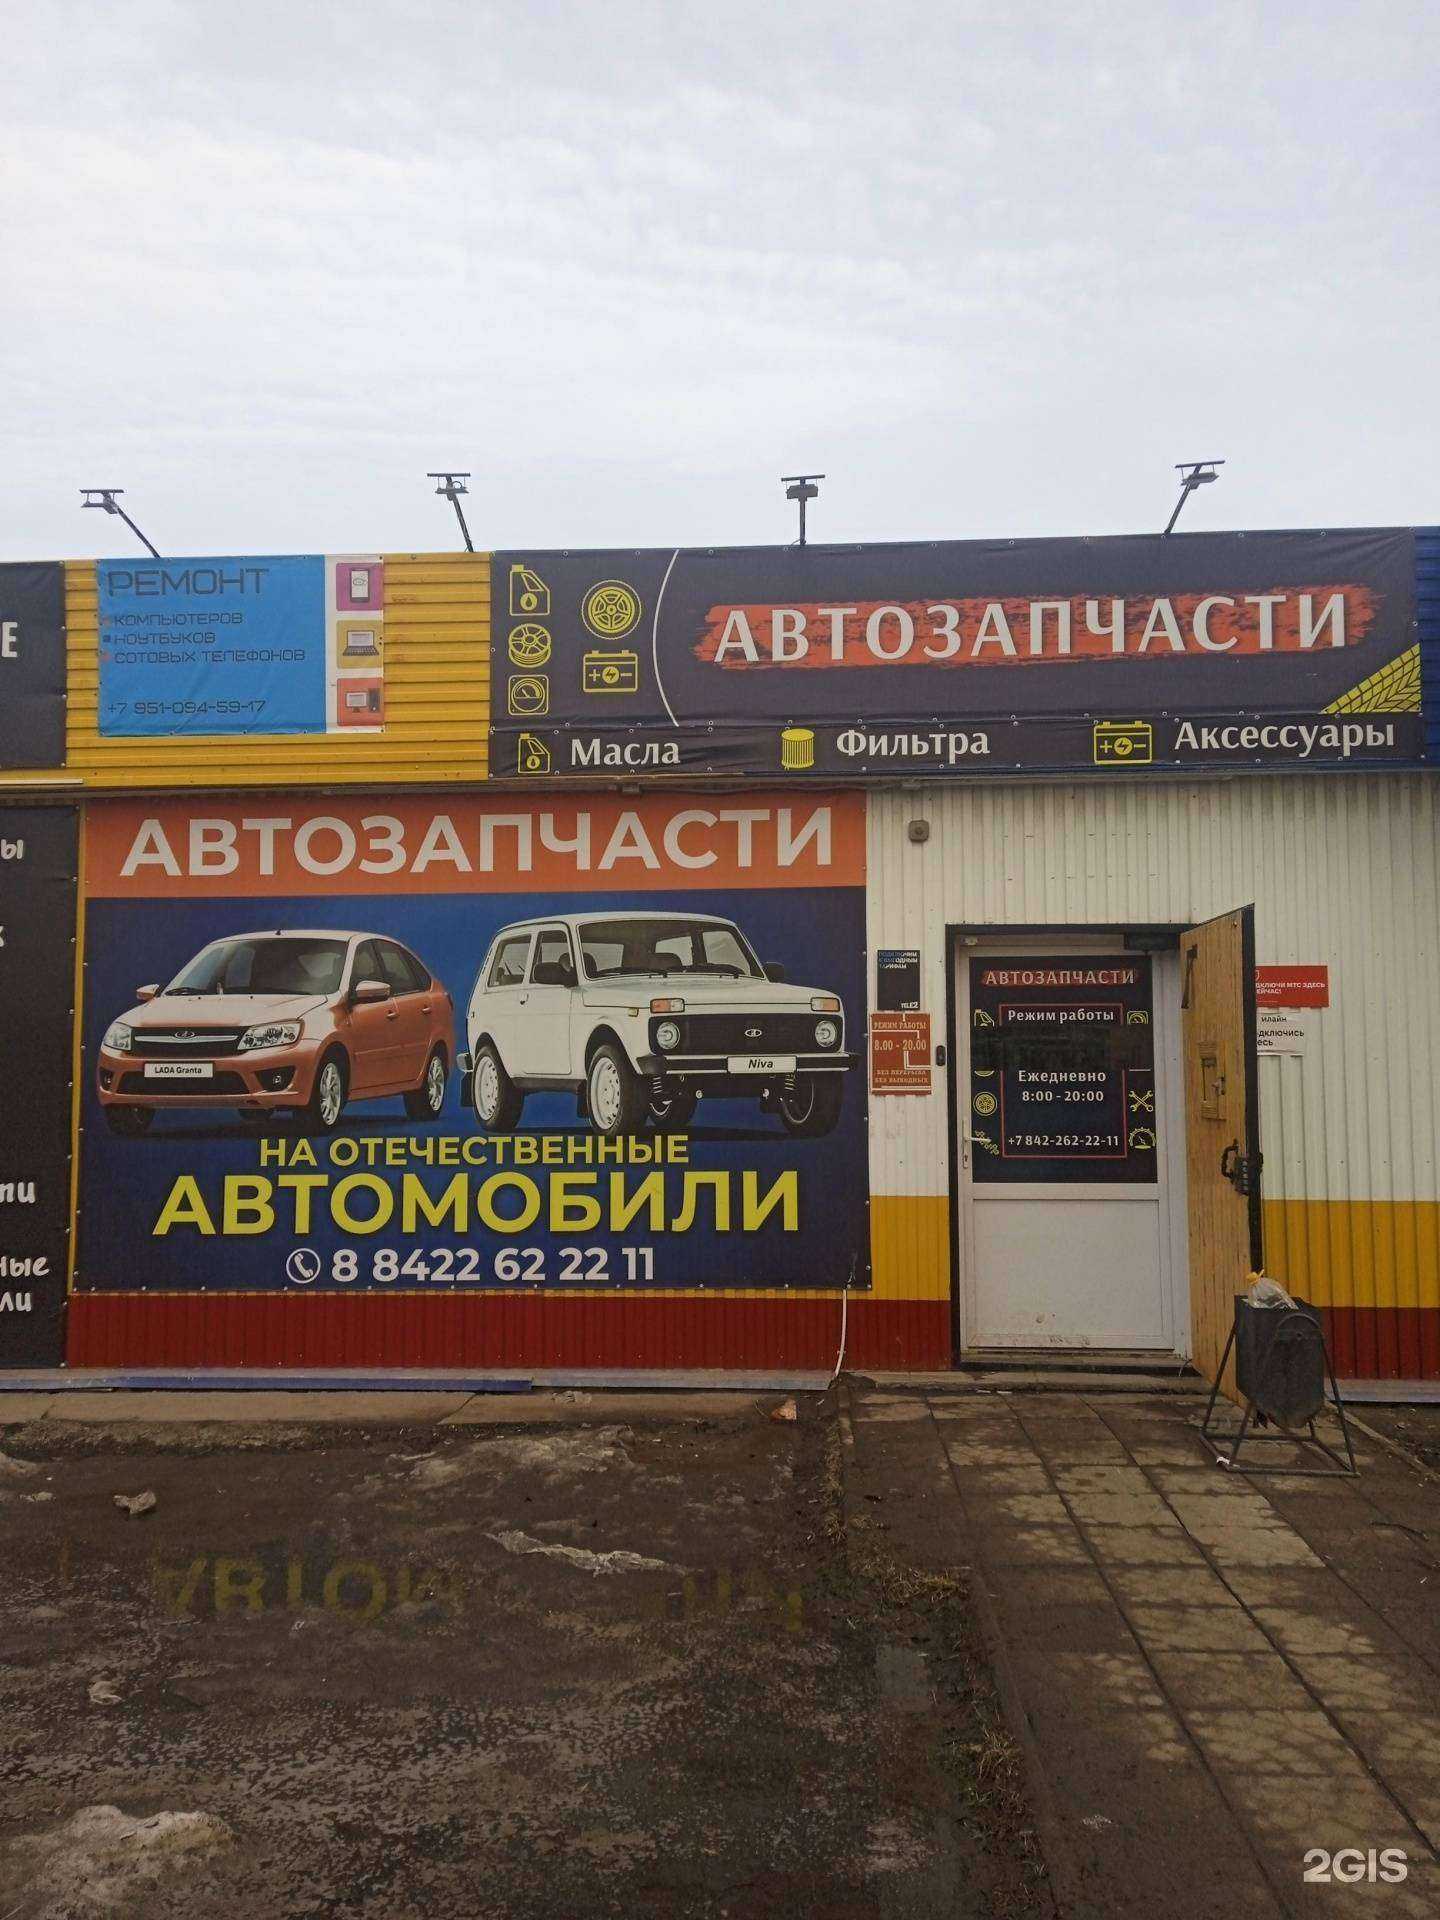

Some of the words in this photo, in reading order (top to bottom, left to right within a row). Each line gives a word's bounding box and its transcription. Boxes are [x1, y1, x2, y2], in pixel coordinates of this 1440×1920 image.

[107, 568, 269, 597] РЕМОНТ
[114, 612, 243, 627] КОМПЬЮТЕРОВ
[713, 593, 1346, 663] АВТОЗАПЧАСТИ
[114, 632, 216, 646] НОУТБУКОВ
[114, 651, 196, 664] СОТОВЫХ
[203, 649, 306, 663] ТЕЛЕФОНОВ
[107, 702, 128, 715] +7
[134, 700, 266, 715] 951-094-59-17
[1174, 721, 1394, 757] Аксессуары
[571, 738, 681, 767] Масла
[836, 729, 990, 765] Фильтра
[120, 807, 832, 877] АВТОЗАПЧАСТИ
[985, 970, 1135, 985] АВТОЗАПЧАСТИ
[1008, 1010, 1056, 1021] Режим
[1059, 1009, 1114, 1024] работы
[874, 1039, 893, 1051] 8.00
[902, 1039, 927, 1051] 20.00
[154, 1066, 174, 1075] LADA
[176, 1066, 202, 1075] Granta
[748, 1057, 774, 1070] Niva
[1018, 1070, 1106, 1083] Ежедневно
[1022, 1091, 1053, 1102] 8:00
[1065, 1091, 1104, 1102] 20:00
[1025, 1135, 1119, 1147] 842-262-22-11
[260, 1138, 318, 1167] НА
[329, 1135, 690, 1167] ОТЕЧЕСТВЕННЫЕ
[152, 1170, 799, 1236] АВТОМОБИЛИ
[332, 1248, 359, 1282] 8
[372, 1248, 480, 1282] 84422
[494, 1247, 546, 1281] 62
[558, 1247, 610, 1281] 22
[622, 1247, 655, 1281] 11
